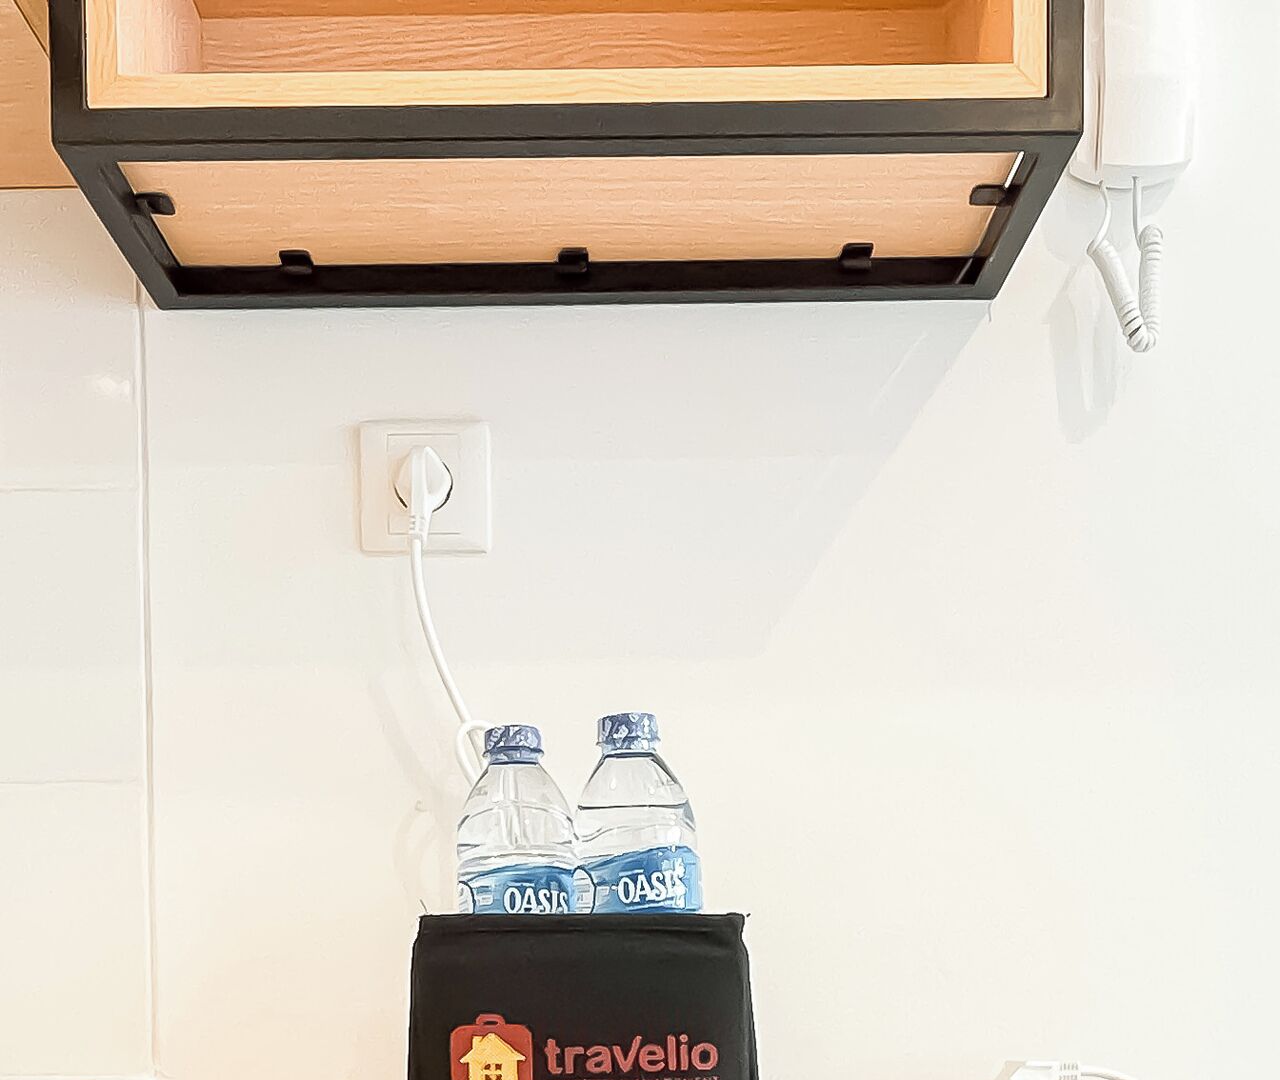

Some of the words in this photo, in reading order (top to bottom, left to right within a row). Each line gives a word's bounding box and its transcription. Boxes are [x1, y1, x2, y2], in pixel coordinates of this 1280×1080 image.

[503, 885, 569, 914] OASIS
[617, 871, 687, 904] OASIS
[544, 1034, 719, 1075] travelio
